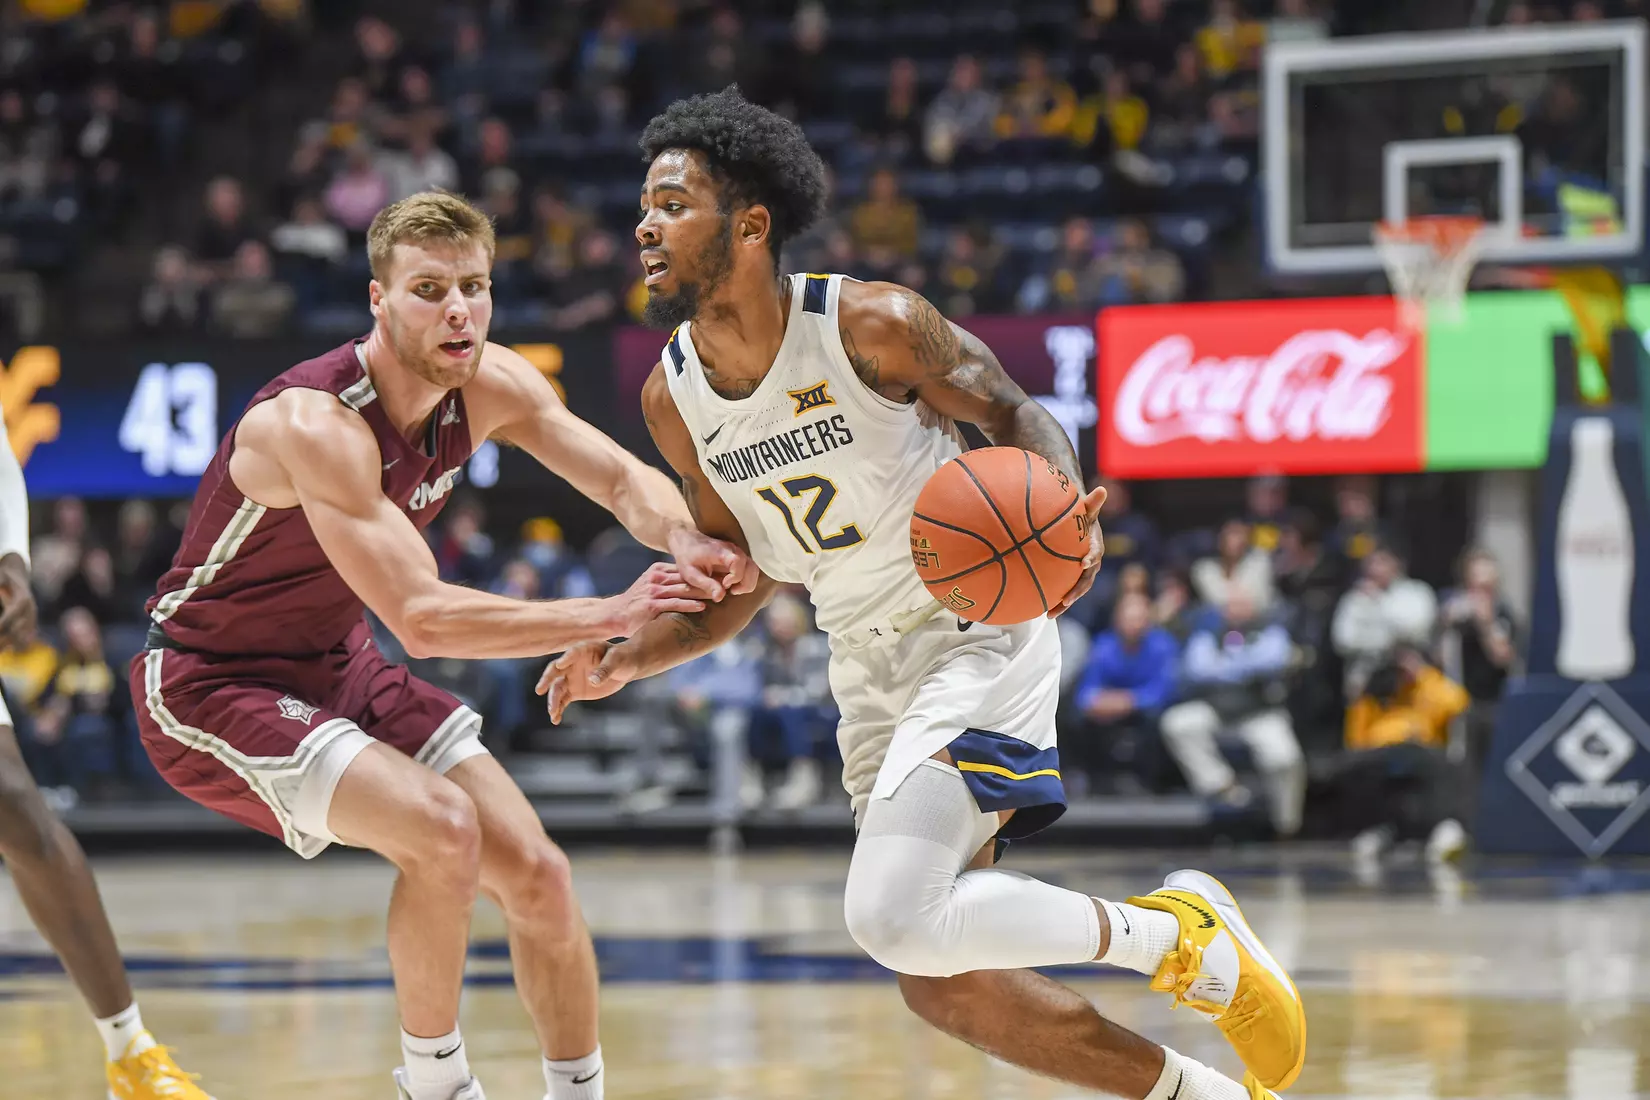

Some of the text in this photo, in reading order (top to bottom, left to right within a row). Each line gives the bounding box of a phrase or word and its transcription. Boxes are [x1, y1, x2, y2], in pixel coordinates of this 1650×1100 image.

[119, 362, 218, 477] 43
[788, 380, 836, 416] XII
[707, 414, 854, 484] MOUNTAINEERS
[754, 473, 866, 555] 12
